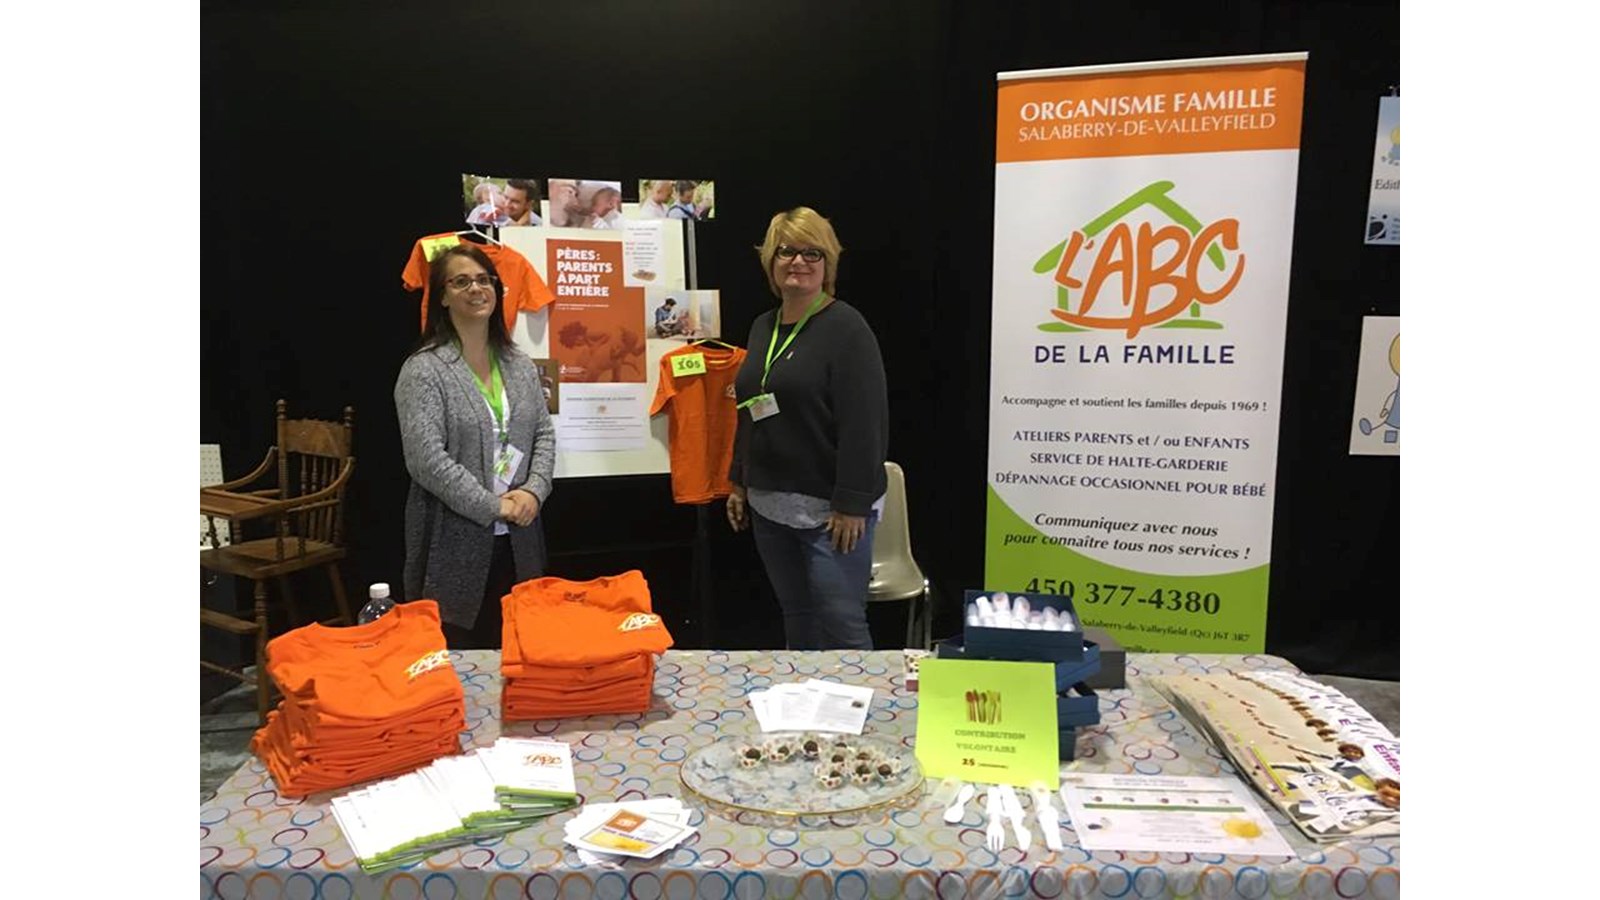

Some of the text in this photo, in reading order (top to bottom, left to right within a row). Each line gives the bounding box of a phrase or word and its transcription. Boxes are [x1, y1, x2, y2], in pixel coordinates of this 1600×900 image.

[1020, 87, 1276, 122] ORGANISME FAMILLE
[1018, 113, 1276, 142] SALABERRY-DE-VALLEYFIELD
[1375, 179, 1400, 190] Edit
[556, 261, 613, 273] PARENTS
[568, 273, 601, 285] PART
[1050, 218, 1245, 339] L'ABC
[557, 283, 609, 297] ENTIÈRE
[1034, 345, 1235, 364] DE LA FAMILLE
[1002, 396, 1067, 408] Accompagne
[1069, 398, 1080, 407] et
[1082, 397, 1125, 408] soutient
[1127, 398, 1142, 408] les
[1145, 398, 1188, 409] familles
[1190, 400, 1228, 412] depuis
[1231, 401, 1260, 412] 1969
[1013, 430, 1071, 442] ATELIERS
[1074, 432, 1134, 445] PARENTS
[1137, 436, 1150, 446] et
[1163, 438, 1180, 447] ou
[1184, 436, 1250, 450] ENFANTS
[1030, 452, 1229, 472] SERVICE DE HALTE-GARDERIE
[995, 471, 1267, 497] DÉPANNAGE OCCASIONNEL POUR BÉBÉ
[1035, 513, 1219, 537] Communiquez avec nous
[1003, 533, 1037, 546] pour
[1041, 535, 1109, 550] connaître
[1113, 539, 1144, 552] tous
[1147, 543, 1174, 554] nos
[1177, 543, 1239, 559] services
[1084, 582, 1221, 615] 377-4380
[954, 729, 1026, 740] CONTRIBUTION
